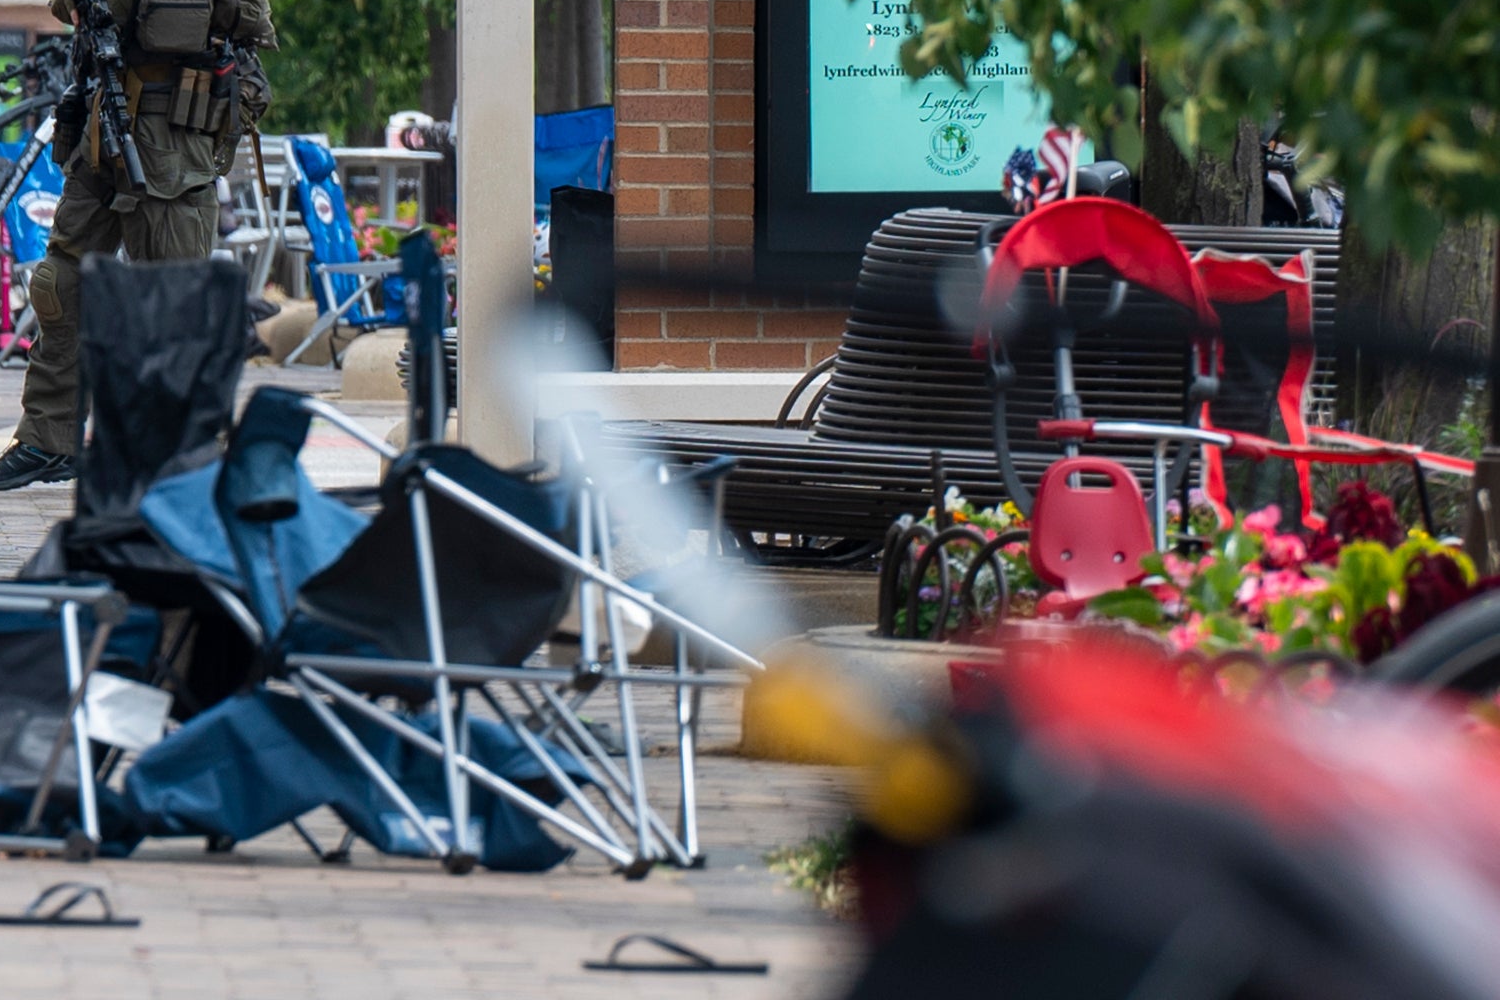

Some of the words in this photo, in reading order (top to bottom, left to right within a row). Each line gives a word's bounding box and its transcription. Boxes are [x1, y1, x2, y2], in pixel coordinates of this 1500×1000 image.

[918, 85, 989, 122] Lynfred
[947, 107, 988, 129] Winery
[924, 154, 964, 177] HIGHLAND
[963, 154, 981, 174] PARK
